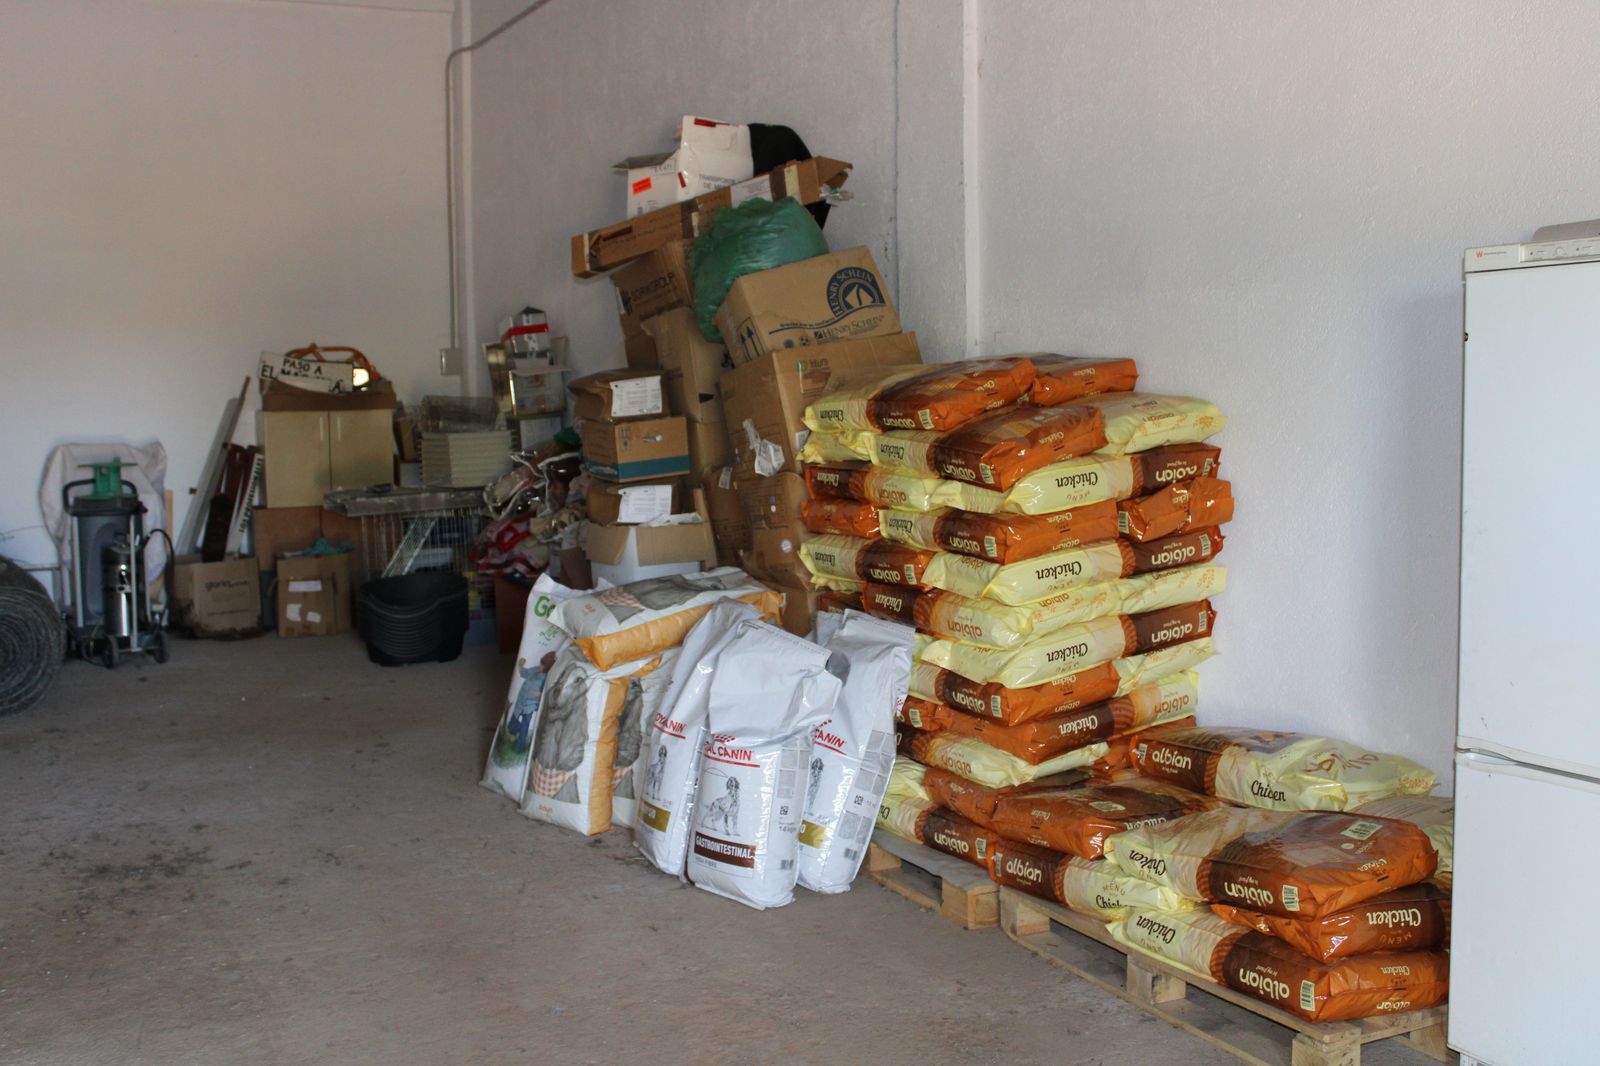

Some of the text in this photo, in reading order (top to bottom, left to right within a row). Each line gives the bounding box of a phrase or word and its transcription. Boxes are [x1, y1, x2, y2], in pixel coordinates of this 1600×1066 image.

[830, 268, 874, 315] HENRY SCHEIN
[261, 365, 277, 379] EL
[283, 358, 310, 372] PASO
[314, 366, 322, 375] A
[880, 444, 904, 460] Chicken
[1055, 471, 1098, 488] Chicken
[877, 491, 906, 504] albian
[888, 518, 913, 532] Chicken
[949, 537, 980, 551] albian
[1151, 545, 1196, 566] albian
[870, 568, 900, 582] albian
[1035, 561, 1082, 581] Chicken
[875, 594, 902, 612] Chicken
[1039, 592, 1069, 606] albian
[947, 621, 982, 639] albian
[947, 621, 982, 639] albian
[1151, 623, 1193, 644] albian
[1046, 642, 1088, 664] Chicken
[952, 691, 985, 712] albian
[1154, 695, 1189, 714] albian
[1059, 715, 1098, 736] Chicken
[717, 746, 752, 761] CANIN
[1151, 748, 1193, 770] albian
[941, 757, 971, 774] albian
[696, 835, 752, 858] GASTROINTESTINAL
[934, 832, 969, 853] albian
[1006, 858, 1041, 883] albian
[1224, 881, 1274, 910] albian
[1366, 907, 1422, 928] Chicken
[1136, 915, 1176, 944] Chicken
[1379, 932, 1412, 944] MENU
[1381, 965, 1410, 976] Chicken
[1239, 967, 1290, 1001] albian
